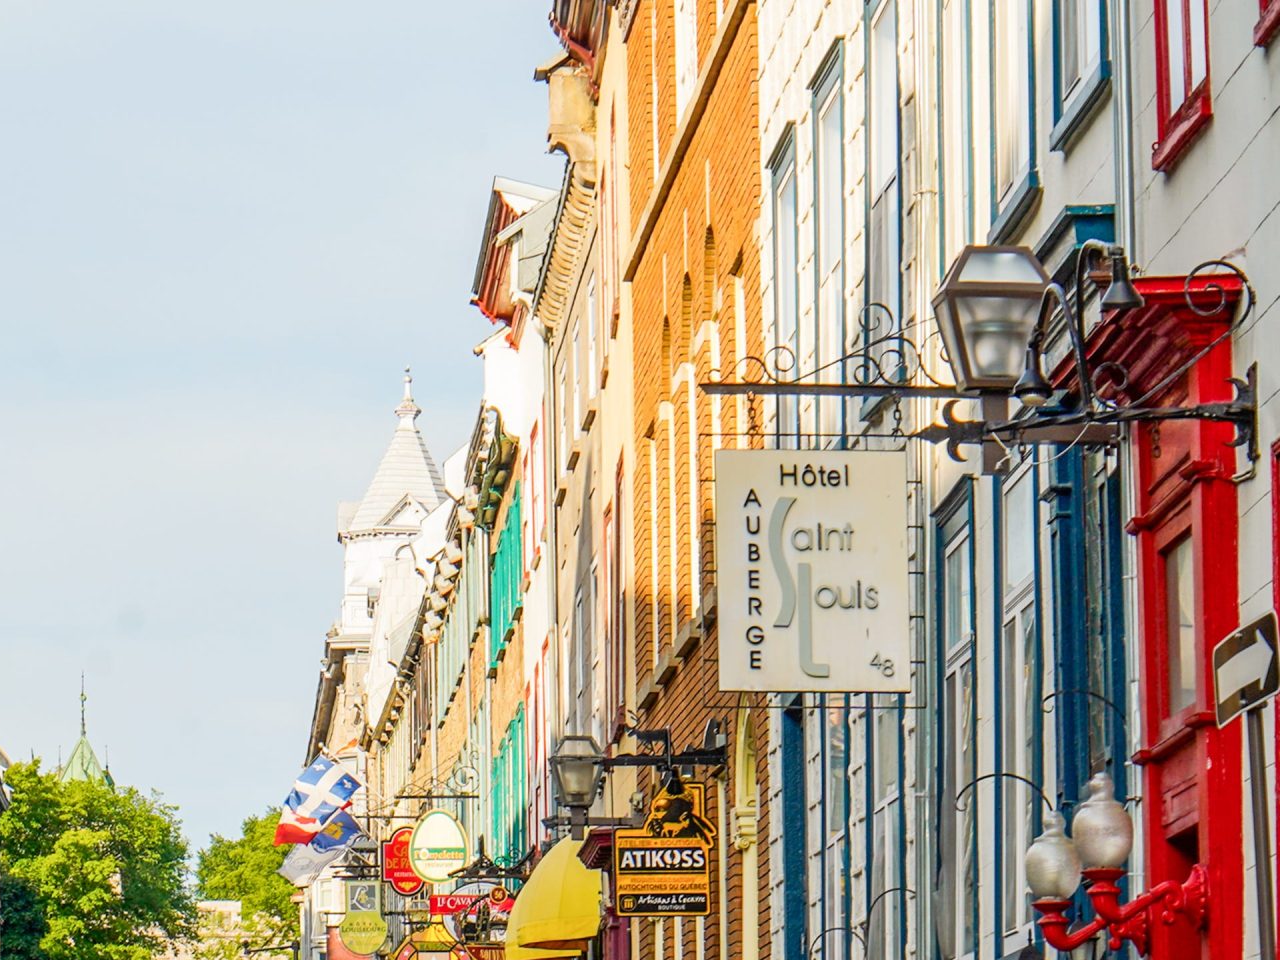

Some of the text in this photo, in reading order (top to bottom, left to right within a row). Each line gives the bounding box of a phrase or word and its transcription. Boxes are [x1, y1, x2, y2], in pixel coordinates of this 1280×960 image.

[780, 464, 849, 486] Hôtel
[743, 488, 764, 669] AUBERGE
[768, 496, 855, 628] Saint
[797, 563, 879, 678] Louis
[869, 652, 895, 677] 48
